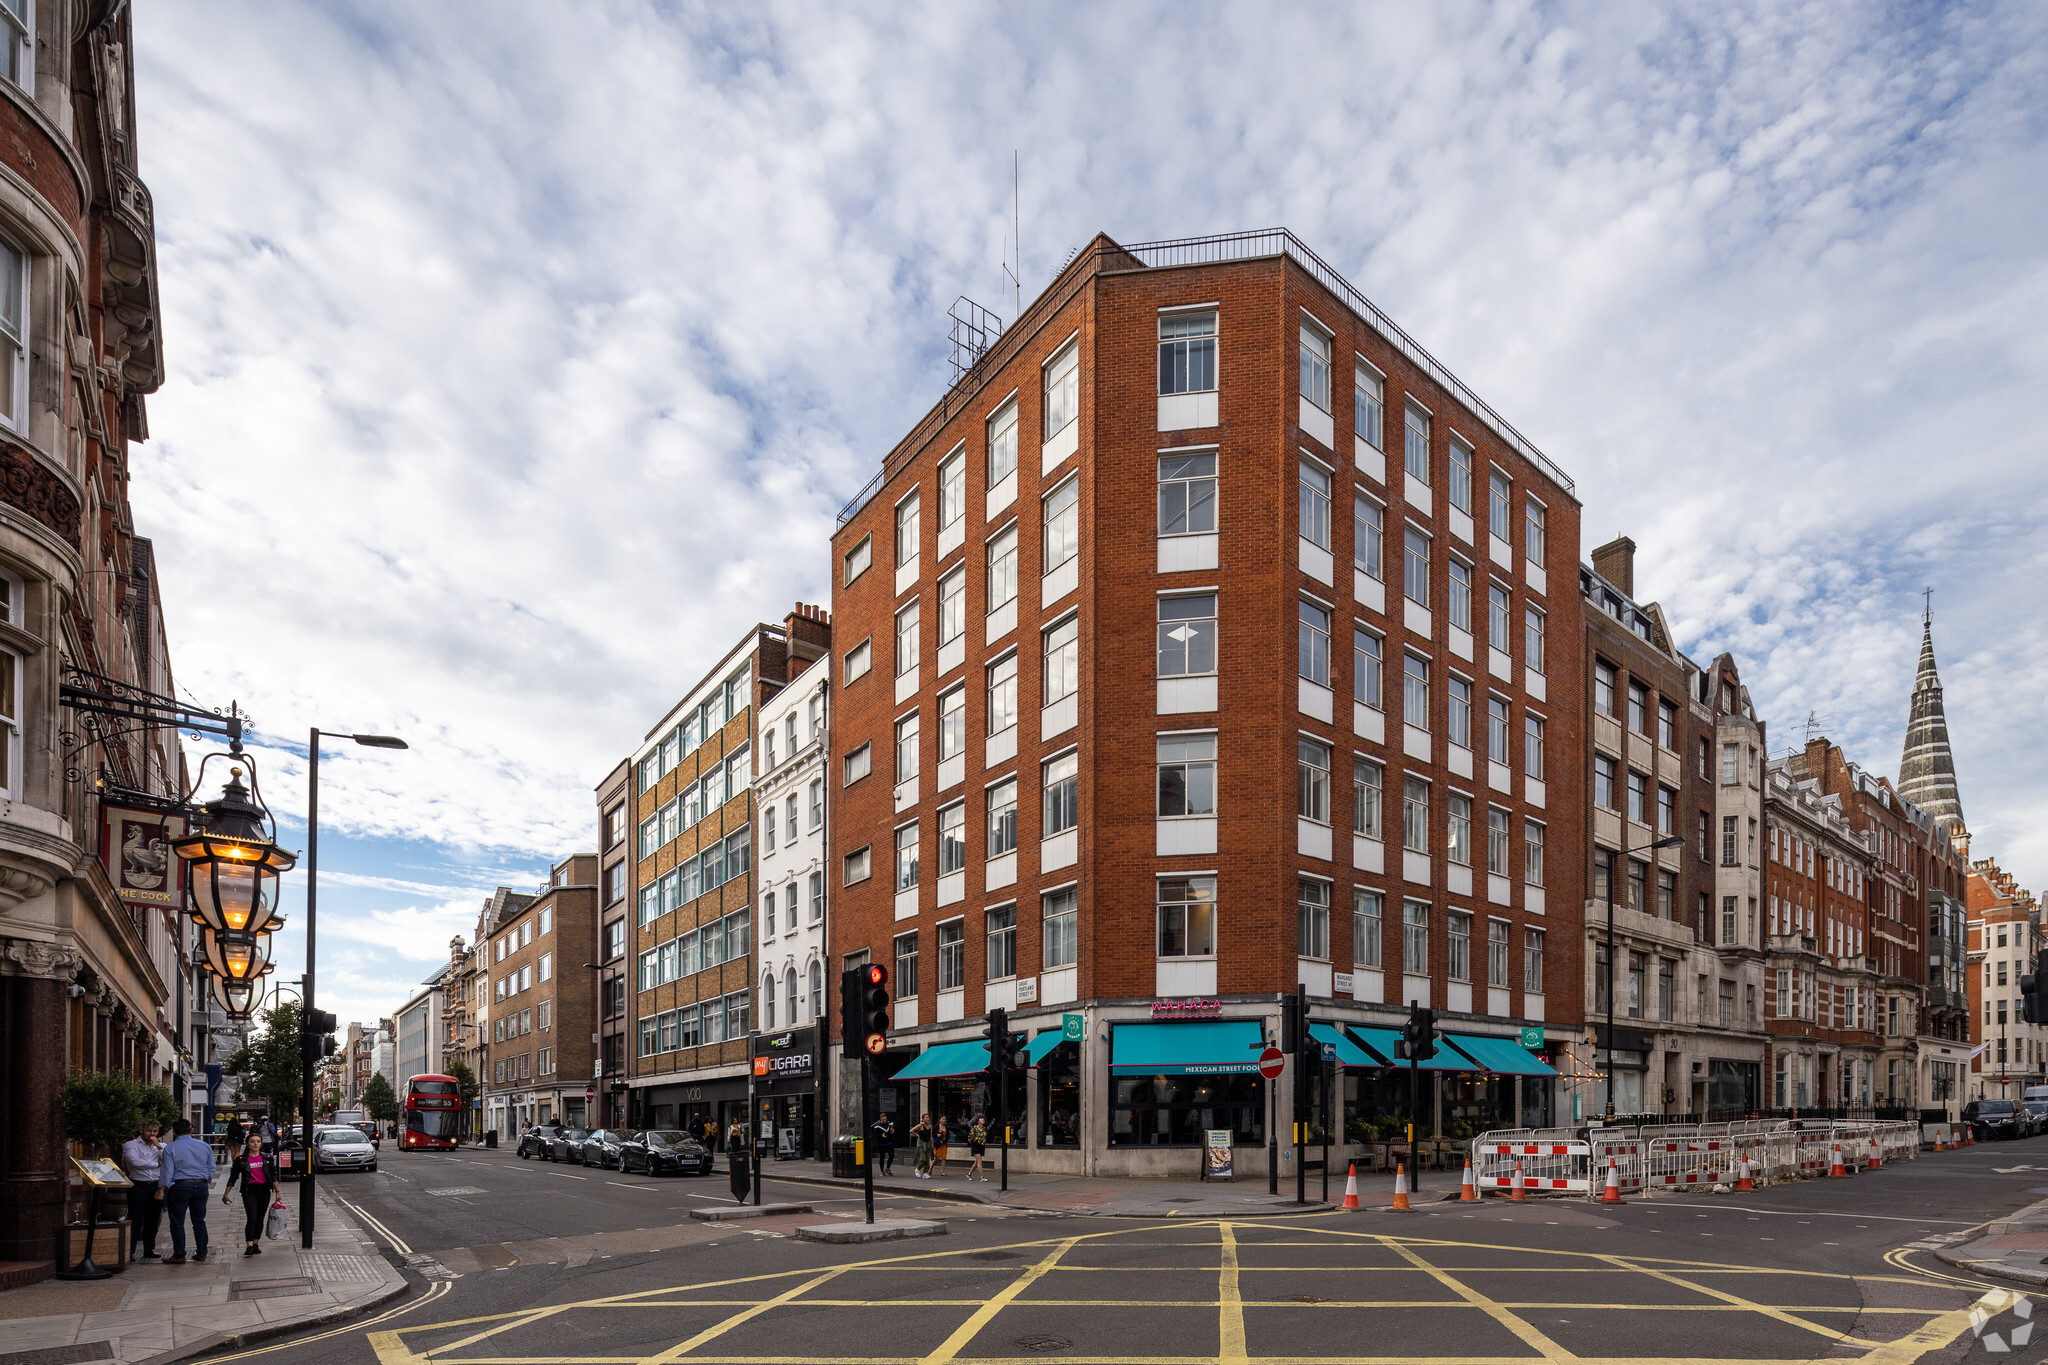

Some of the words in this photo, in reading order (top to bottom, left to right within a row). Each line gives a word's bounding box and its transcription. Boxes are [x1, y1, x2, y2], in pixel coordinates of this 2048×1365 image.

[141, 891, 172, 902] COCK
[1151, 1000, 1222, 1010] WAHACA
[768, 1054, 812, 1070] CIGARA
